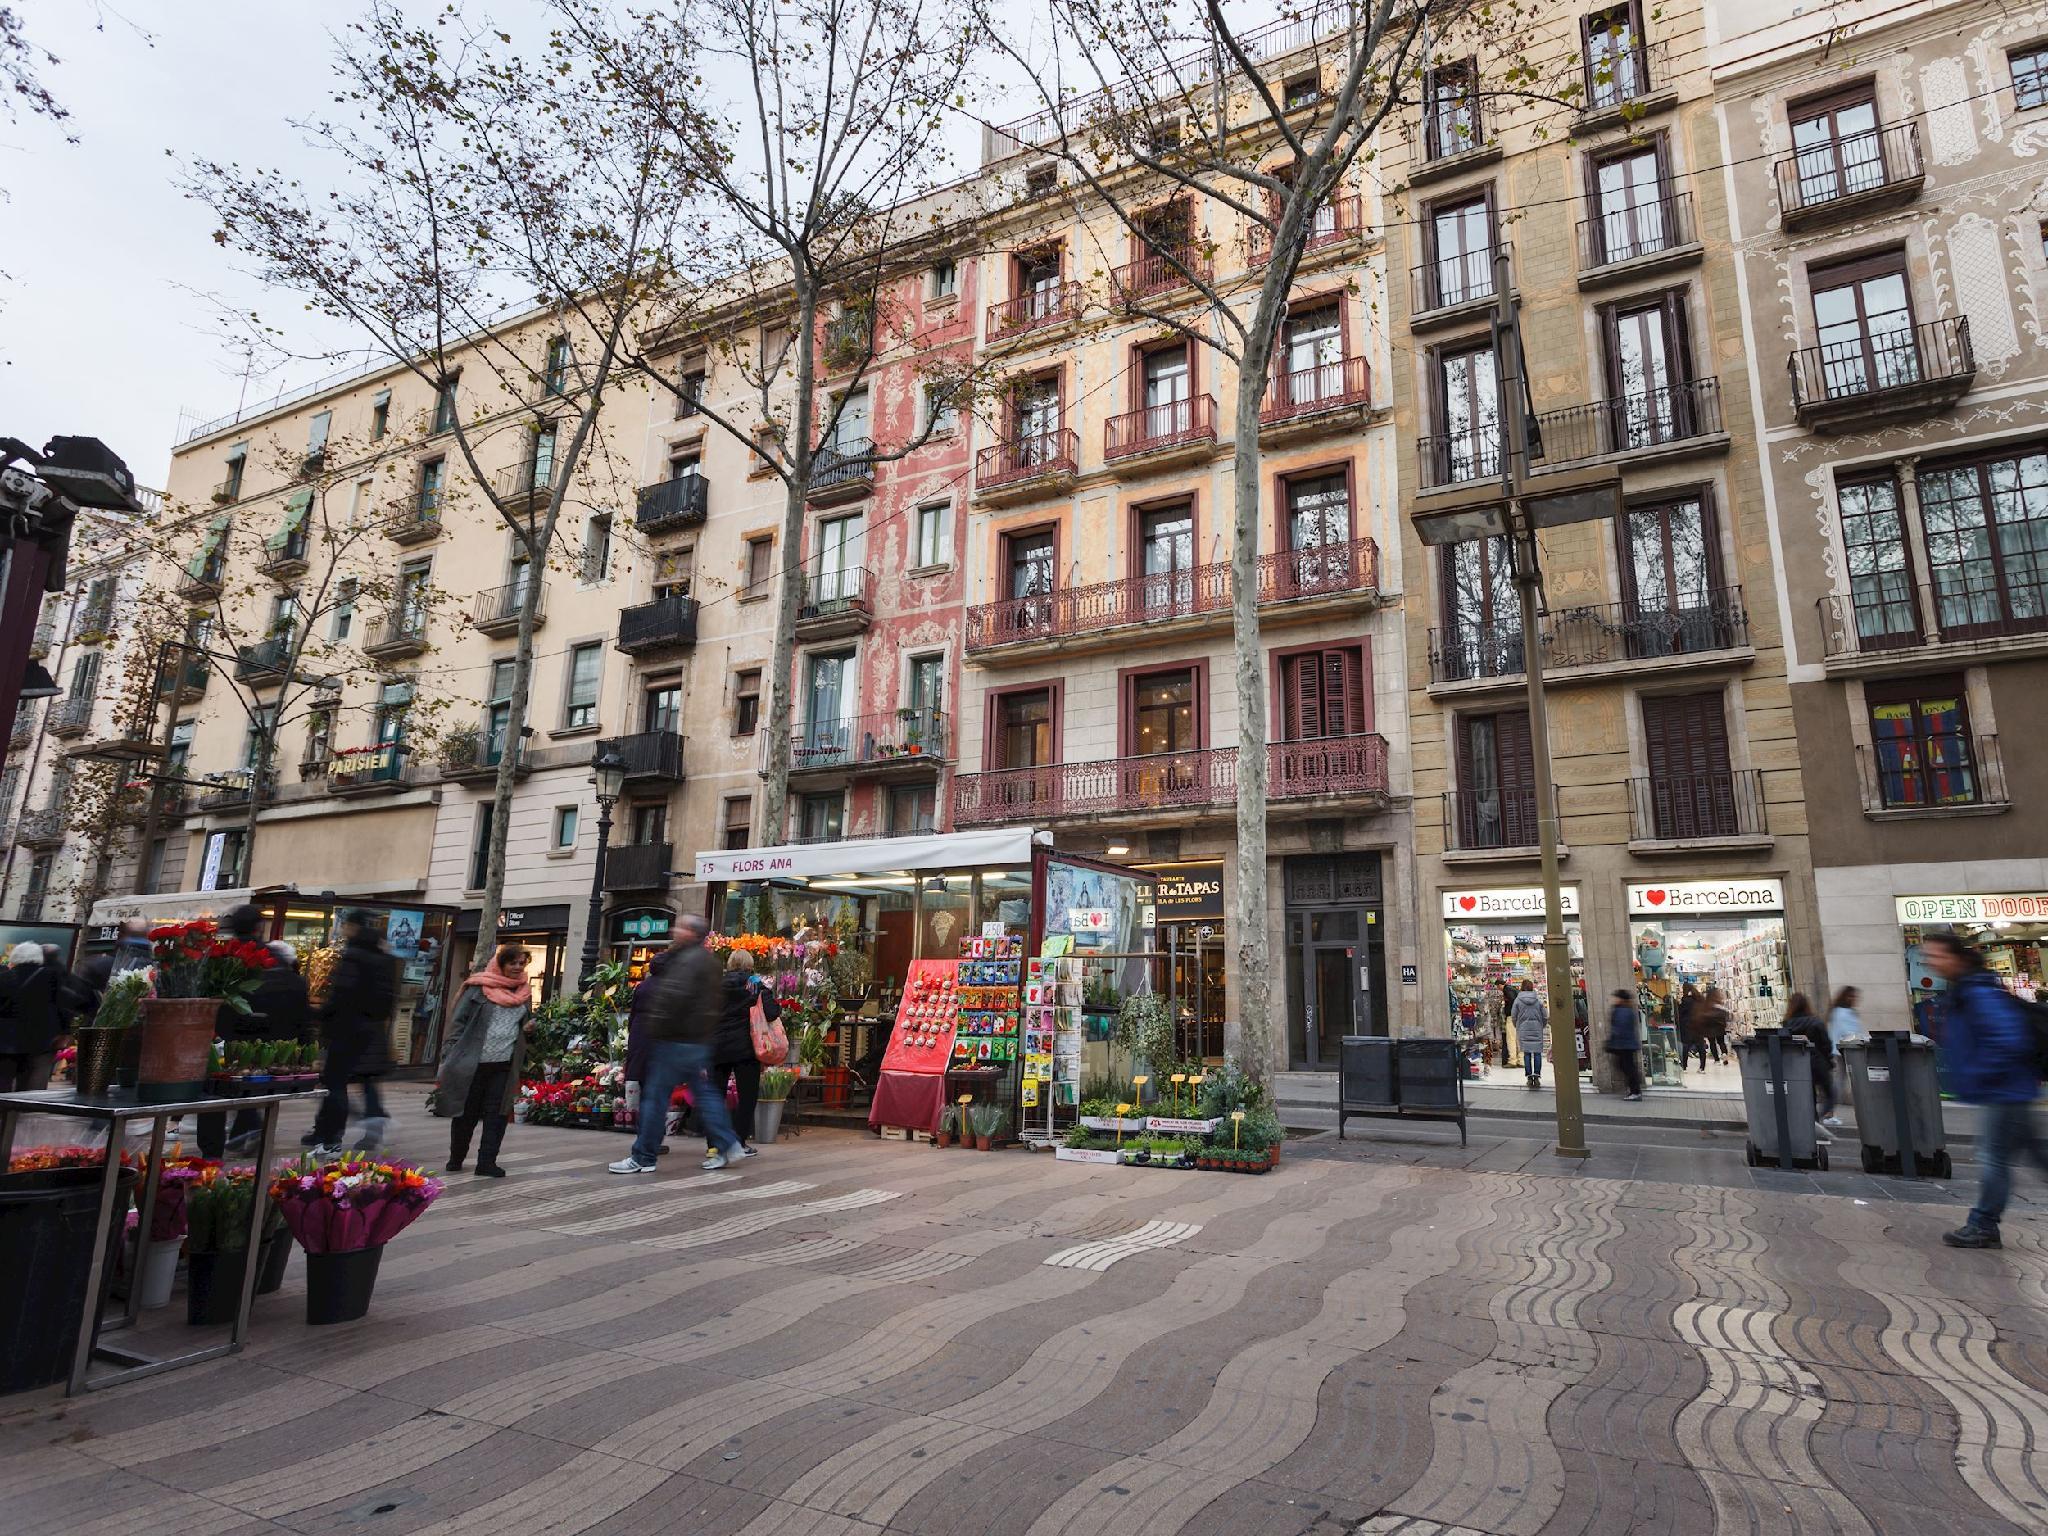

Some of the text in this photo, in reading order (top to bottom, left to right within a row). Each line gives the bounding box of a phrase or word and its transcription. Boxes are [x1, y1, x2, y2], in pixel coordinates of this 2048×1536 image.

[702, 858, 792, 874] 15 FLORS ANA
[1176, 881, 1220, 896] TAPAS
[1449, 897, 1457, 912] I
[1635, 888, 1775, 908] I Barcelona
[1905, 899, 1977, 919] OPEN
[1402, 967, 1415, 976] HA
